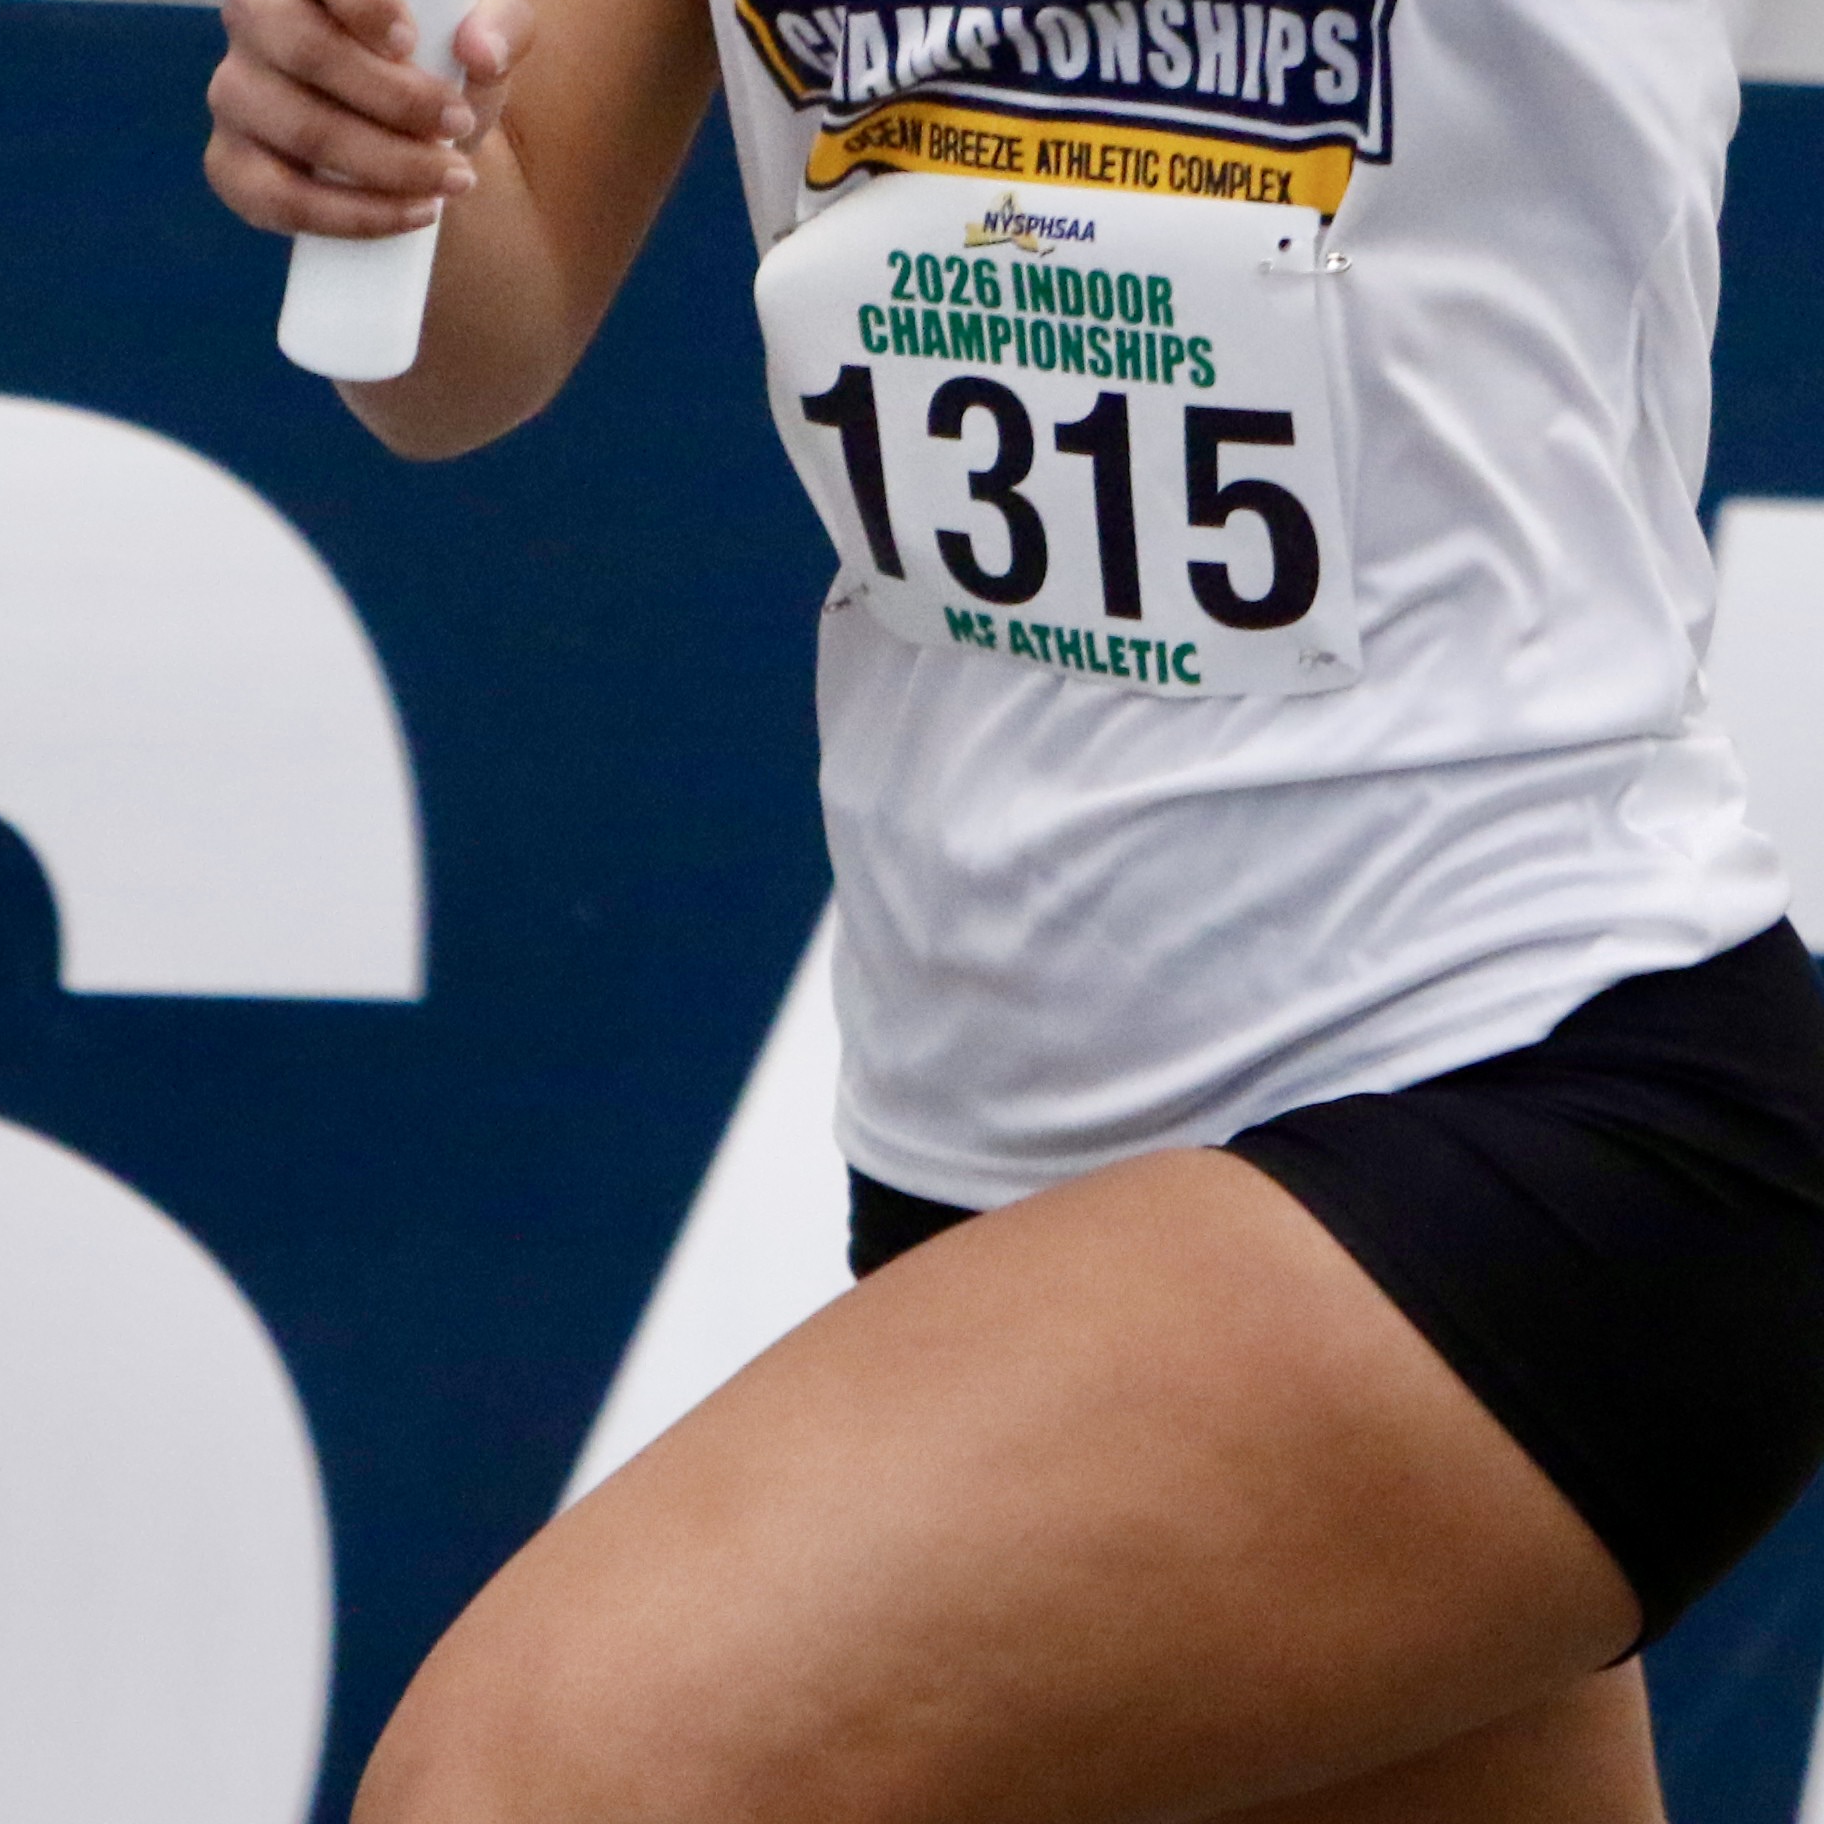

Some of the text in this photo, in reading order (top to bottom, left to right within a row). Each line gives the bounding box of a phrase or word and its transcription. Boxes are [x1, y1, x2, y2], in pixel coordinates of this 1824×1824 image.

[928, 123, 1025, 174] BREEZE
[1035, 137, 1160, 188] ATHLETIC
[1169, 152, 1293, 204] COMPLEX
[983, 211, 1097, 243] NYSPHSAA
[887, 249, 1175, 327] 2026 INDOOR
[857, 303, 1217, 388] CHAMPIONSHIPS
[800, 363, 1320, 631] 1315
[1008, 619, 1202, 686] ATHLETIC
